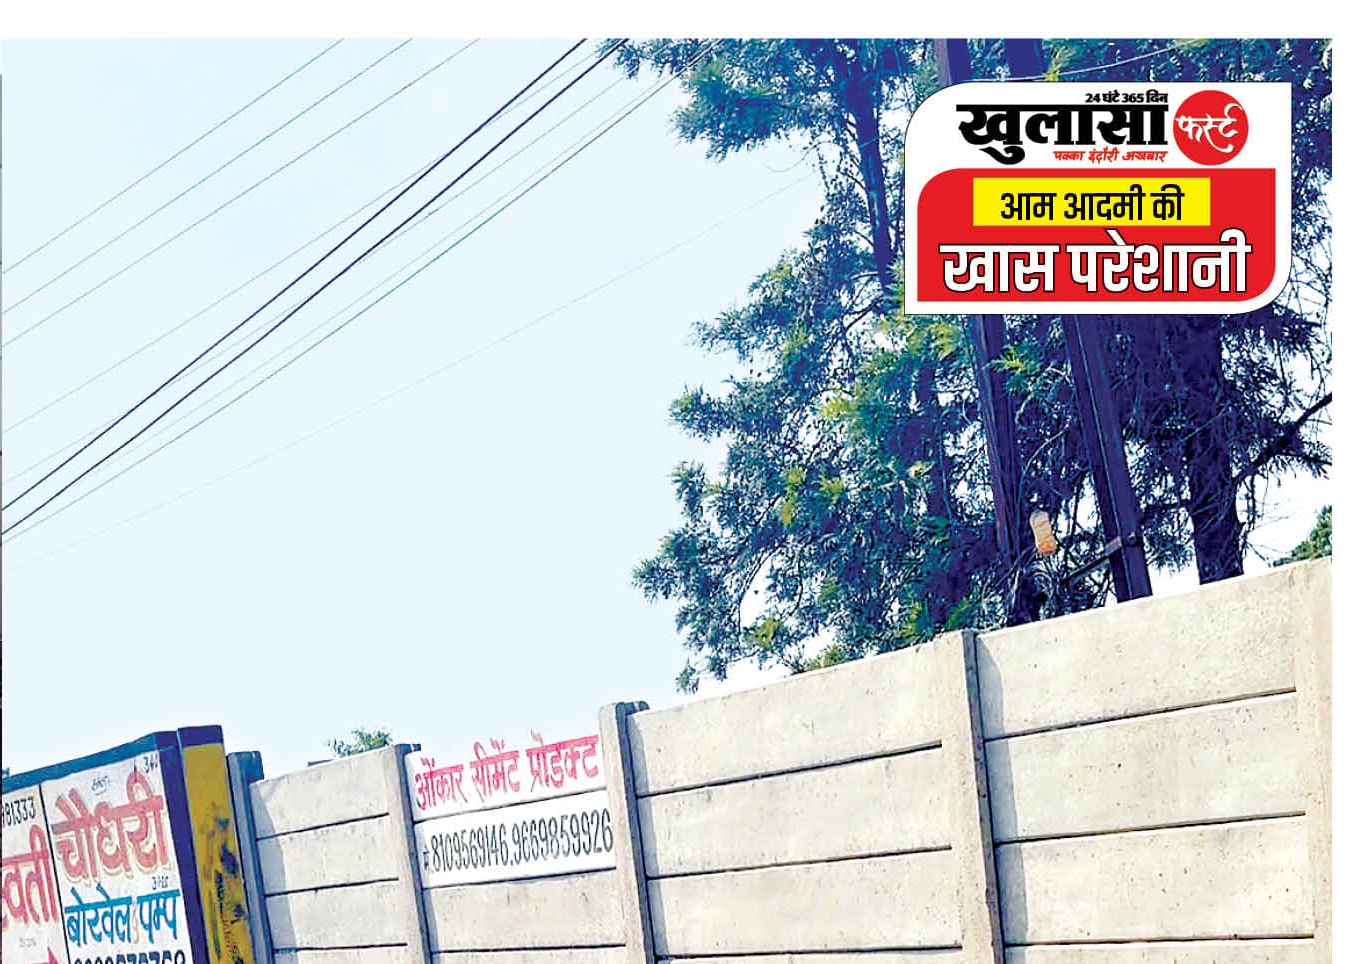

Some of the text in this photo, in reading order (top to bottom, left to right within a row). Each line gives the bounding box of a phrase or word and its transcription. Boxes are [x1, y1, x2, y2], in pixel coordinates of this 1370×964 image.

[51, 770, 170, 881] चौधरी
[64, 883, 181, 946] बोरवेल पम्प
